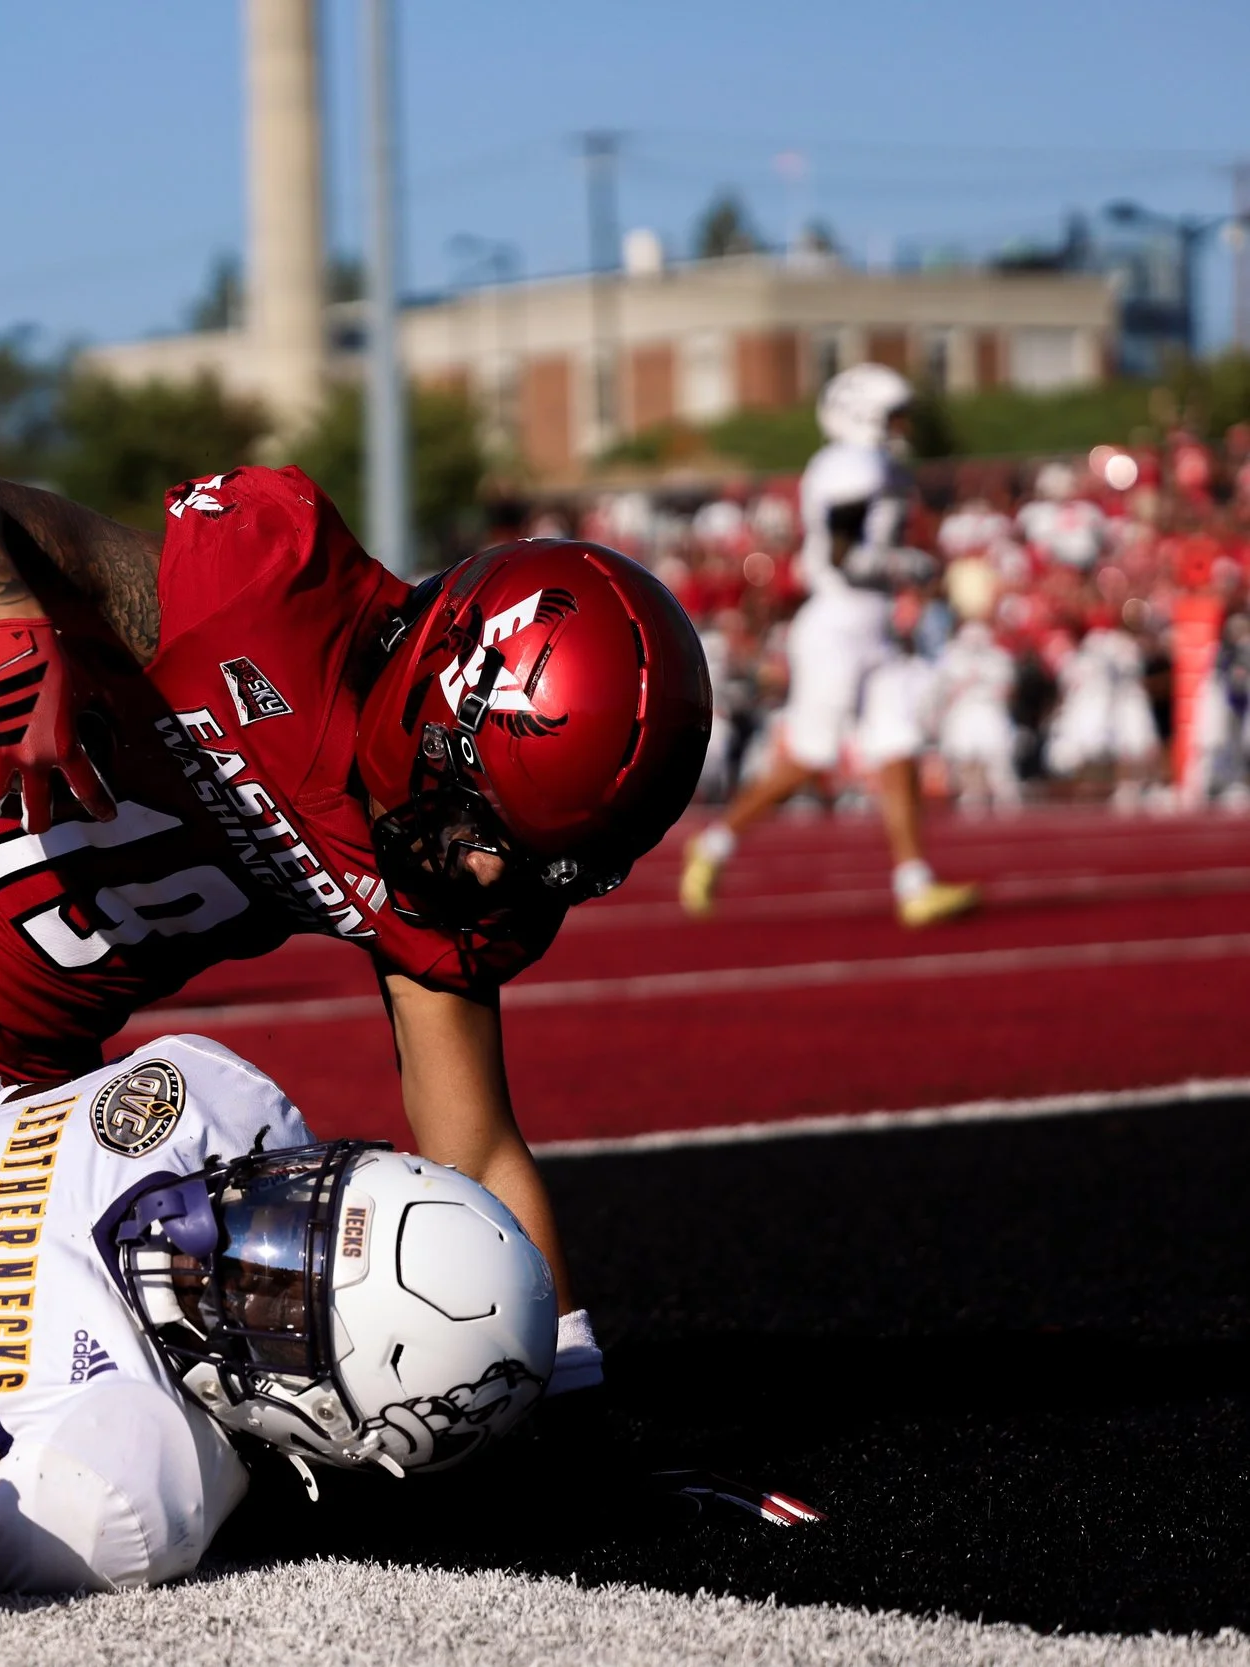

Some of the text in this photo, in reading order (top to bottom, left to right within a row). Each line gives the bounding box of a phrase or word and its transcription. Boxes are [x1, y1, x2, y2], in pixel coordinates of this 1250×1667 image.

[247, 679, 284, 714] SKY
[177, 706, 380, 939] EASTERN
[110, 1075, 162, 1136] OVC
[166, 1069, 178, 1097] OHIO
[342, 1207, 367, 1259] NECKS
